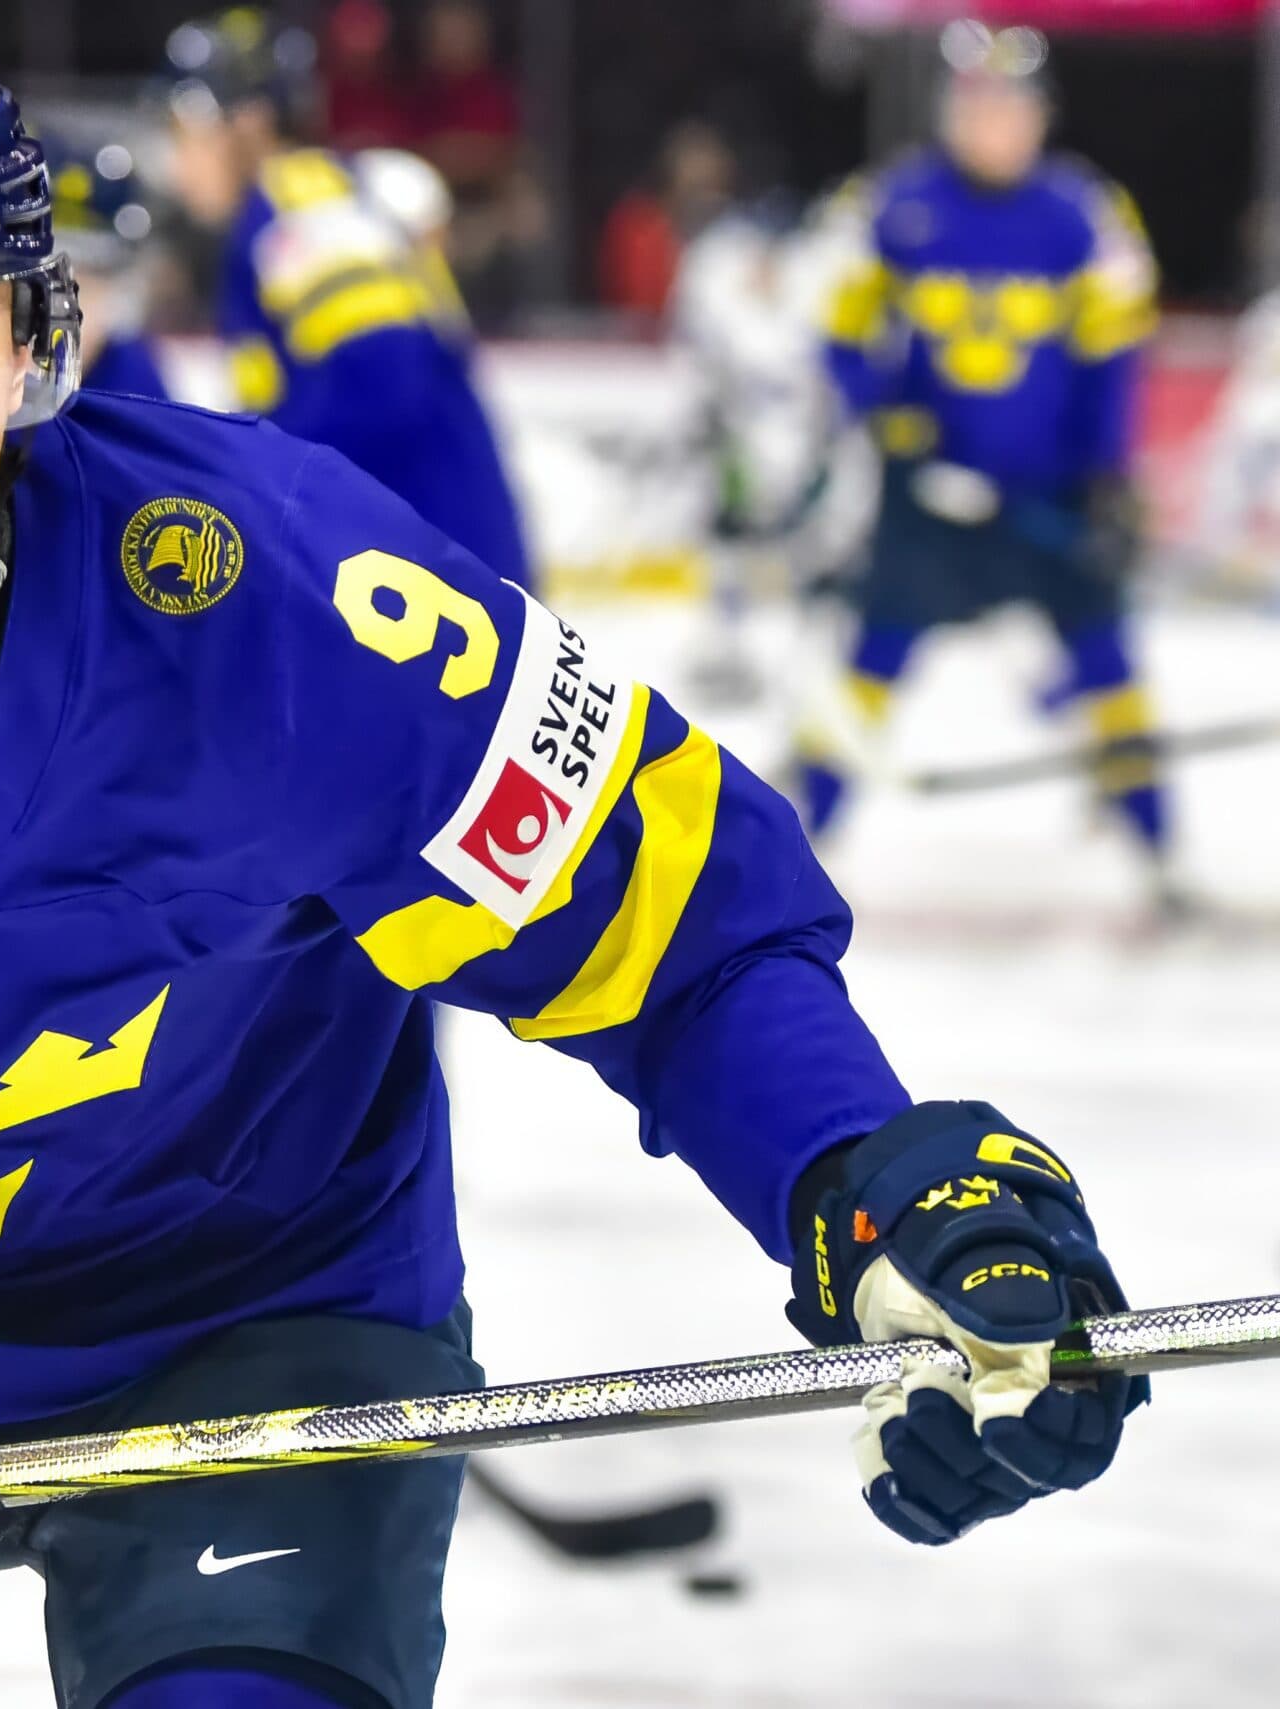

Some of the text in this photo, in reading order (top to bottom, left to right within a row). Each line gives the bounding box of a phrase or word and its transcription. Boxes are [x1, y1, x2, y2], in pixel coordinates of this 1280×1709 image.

[333, 548, 500, 700] 9
[561, 681, 616, 788] SPEL
[814, 1213, 837, 1318] CCM
[961, 1262, 1050, 1292] CCM
